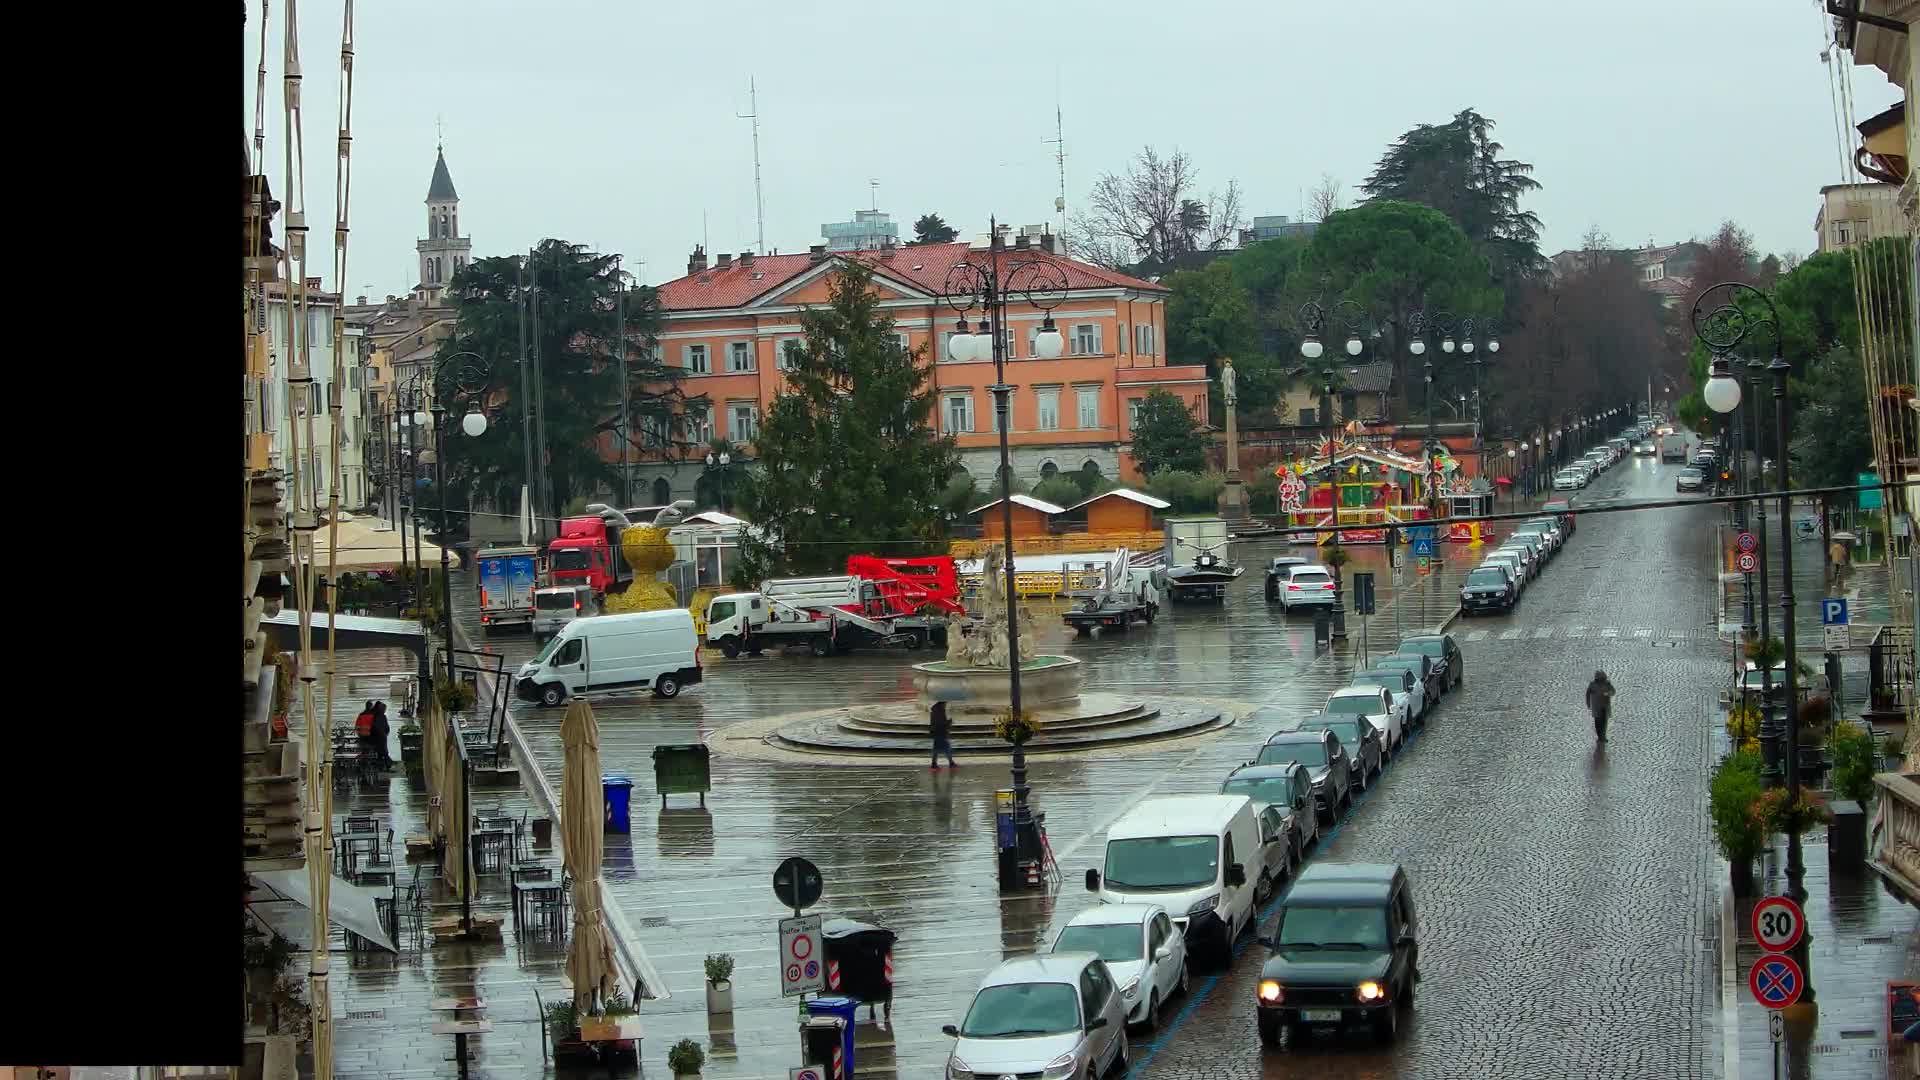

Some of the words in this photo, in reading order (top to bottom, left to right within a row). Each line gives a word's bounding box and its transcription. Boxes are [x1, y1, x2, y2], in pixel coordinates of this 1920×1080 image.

[1742, 558, 1752, 567] 20
[1827, 602, 1841, 621] P
[1763, 912, 1791, 937] 30
[790, 969, 798, 977] 10
